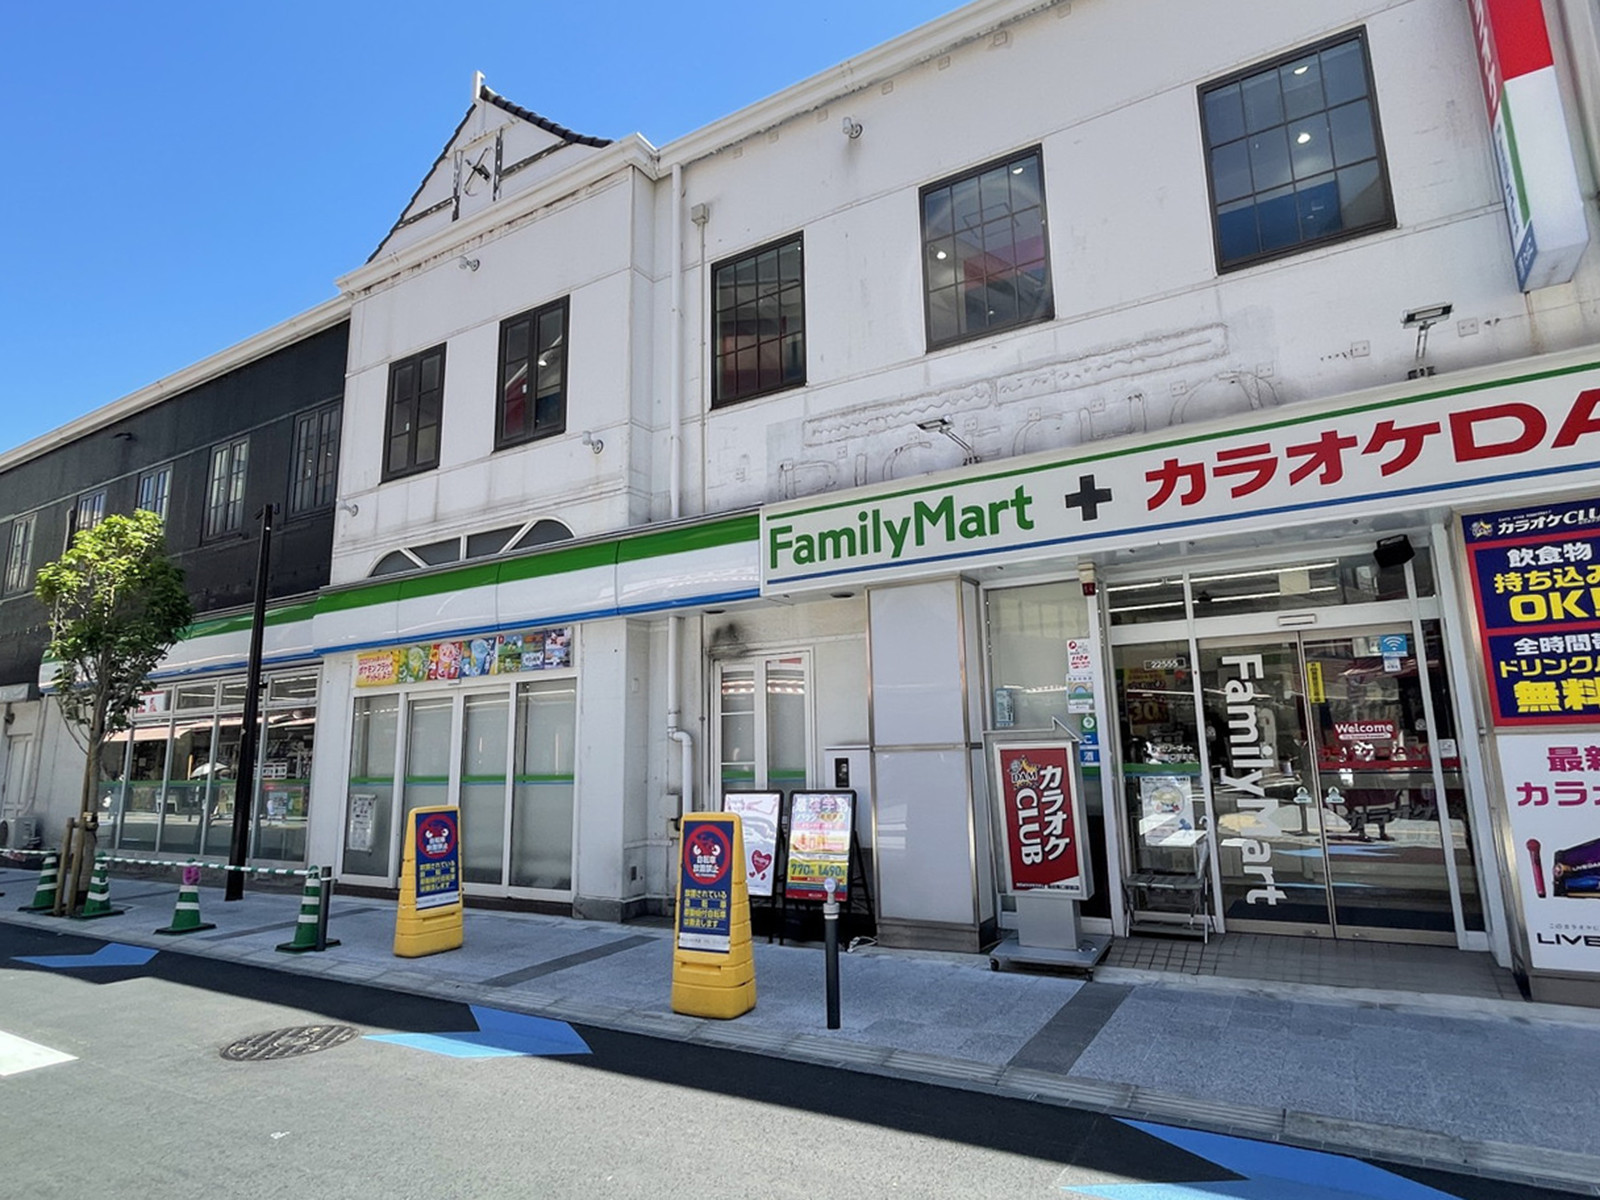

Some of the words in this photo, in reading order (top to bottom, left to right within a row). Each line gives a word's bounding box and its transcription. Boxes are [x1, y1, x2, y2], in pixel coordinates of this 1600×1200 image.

[769, 485, 1035, 570] FamilyMart
[1506, 541, 1593, 568] 飲食物
[1499, 655, 1600, 679] ドリンク
[1513, 676, 1600, 713] 無料
[1335, 723, 1394, 734] Welcome
[1012, 771, 1038, 784] DAM
[1221, 654, 1287, 906] FamilyMart
[1516, 781, 1600, 807] カラ
[1016, 787, 1043, 866] CLUB
[1039, 764, 1070, 861] カラオケ
